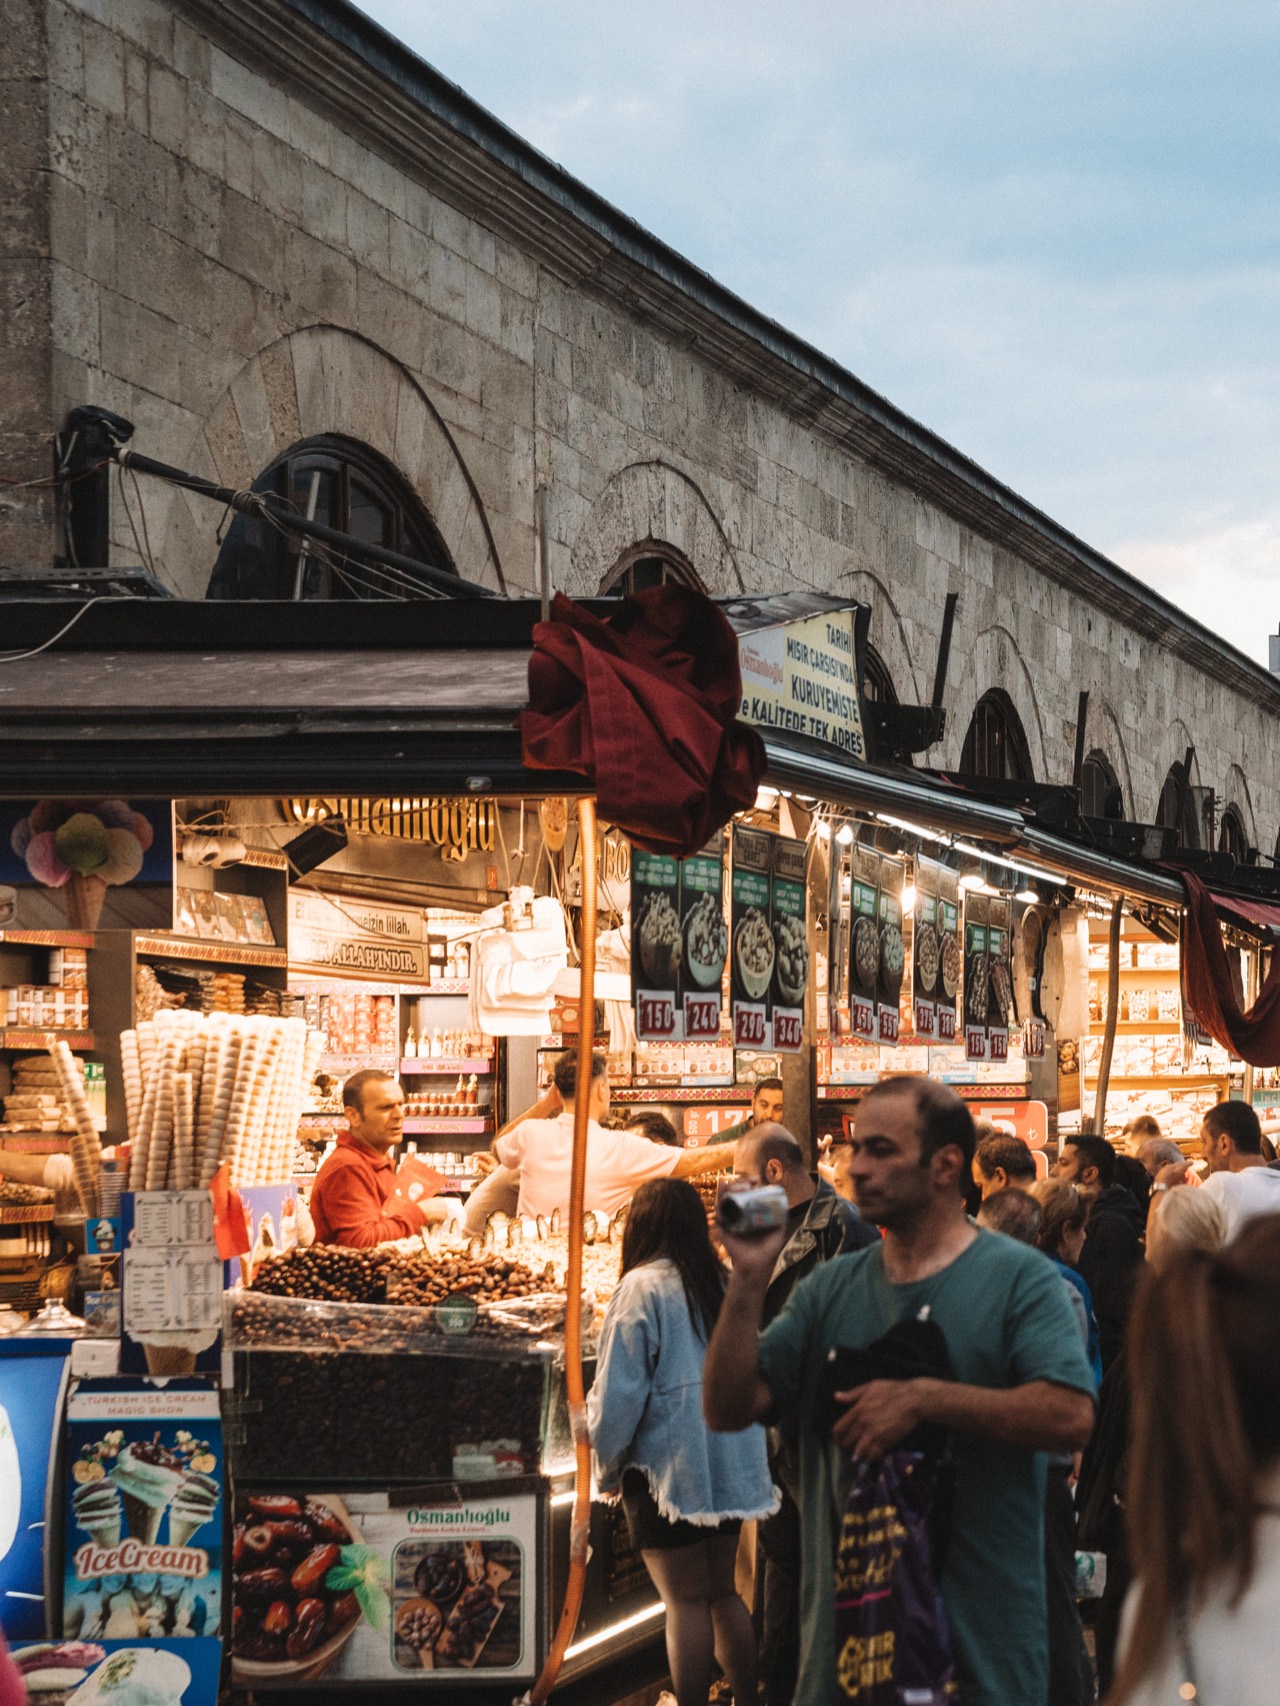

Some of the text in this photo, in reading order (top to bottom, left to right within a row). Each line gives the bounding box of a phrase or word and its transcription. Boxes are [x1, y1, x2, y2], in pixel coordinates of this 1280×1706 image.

[786, 636, 809, 664] MISIR
[826, 623, 852, 654] TARİHİ
[791, 673, 859, 726] KURUYEMİŞTE
[751, 697, 807, 733] KALİTEDE
[809, 716, 830, 741] TEK
[831, 728, 864, 755] ADRES
[646, 1002, 717, 1030] 150 240
[741, 1013, 800, 1043] 290 340
[883, 1012, 898, 1038] 550
[971, 1031, 985, 1054] 150
[688, 1109, 700, 1135] 500 gr
[705, 1109, 753, 1134] 17
[87, 1396, 138, 1404] TURKISH
[166, 1395, 207, 1404] CREAM
[107, 1406, 184, 1415] MAGIC SHOW
[79, 1541, 204, 1575] IceCream
